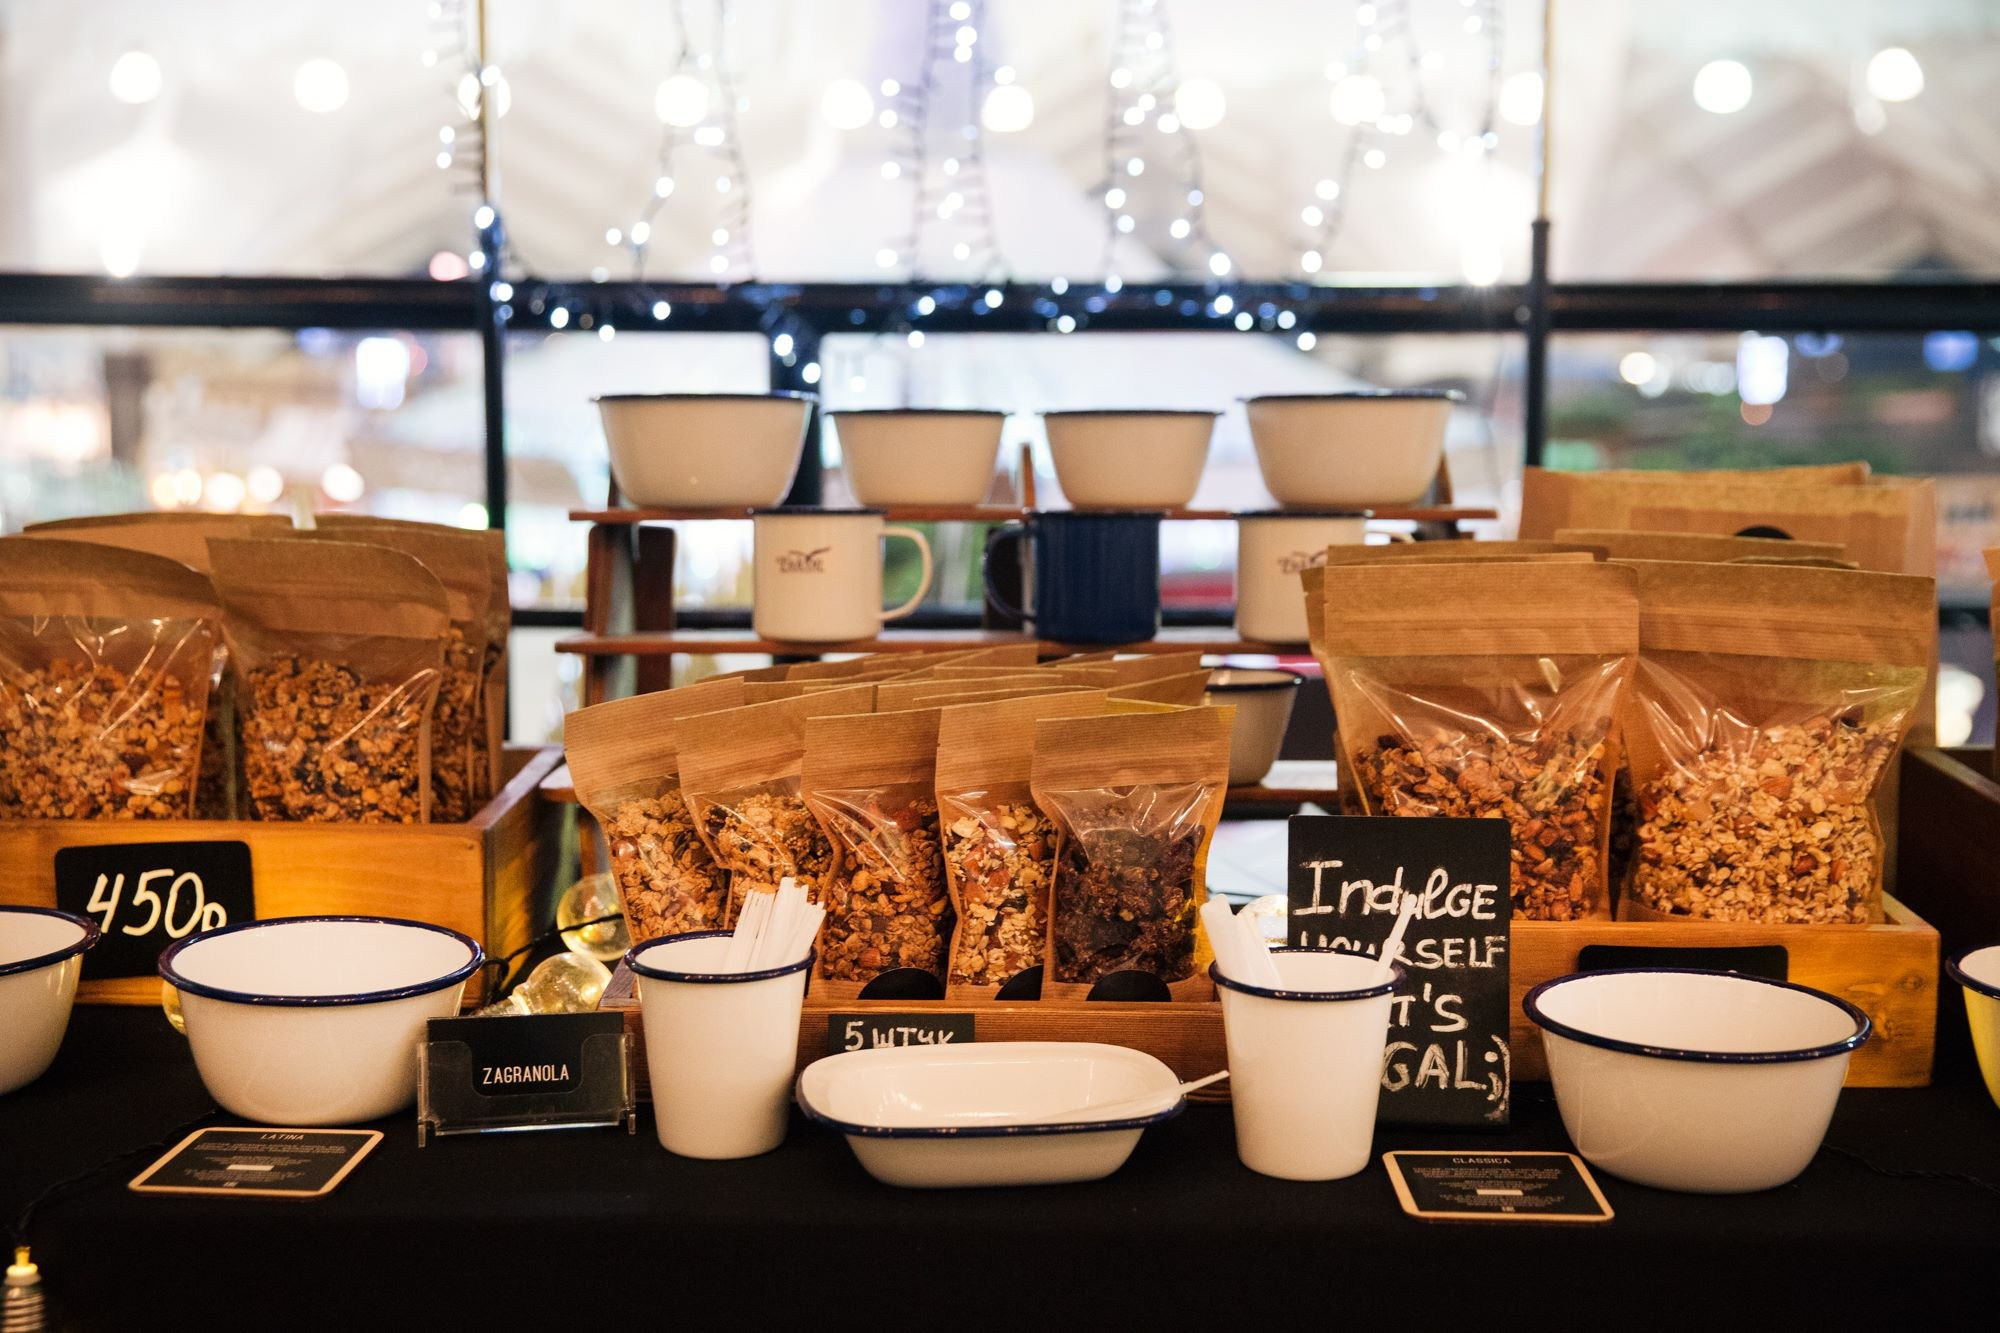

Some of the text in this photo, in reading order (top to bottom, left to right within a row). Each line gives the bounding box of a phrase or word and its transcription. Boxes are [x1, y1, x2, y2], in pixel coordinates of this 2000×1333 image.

[1389, 982, 1469, 1032] T'S
[845, 1020, 864, 1051] 5
[482, 1063, 570, 1085] ZAGRANOLA
[260, 1133, 304, 1141] LATINA
[1452, 1157, 1512, 1165] CLASSICA
